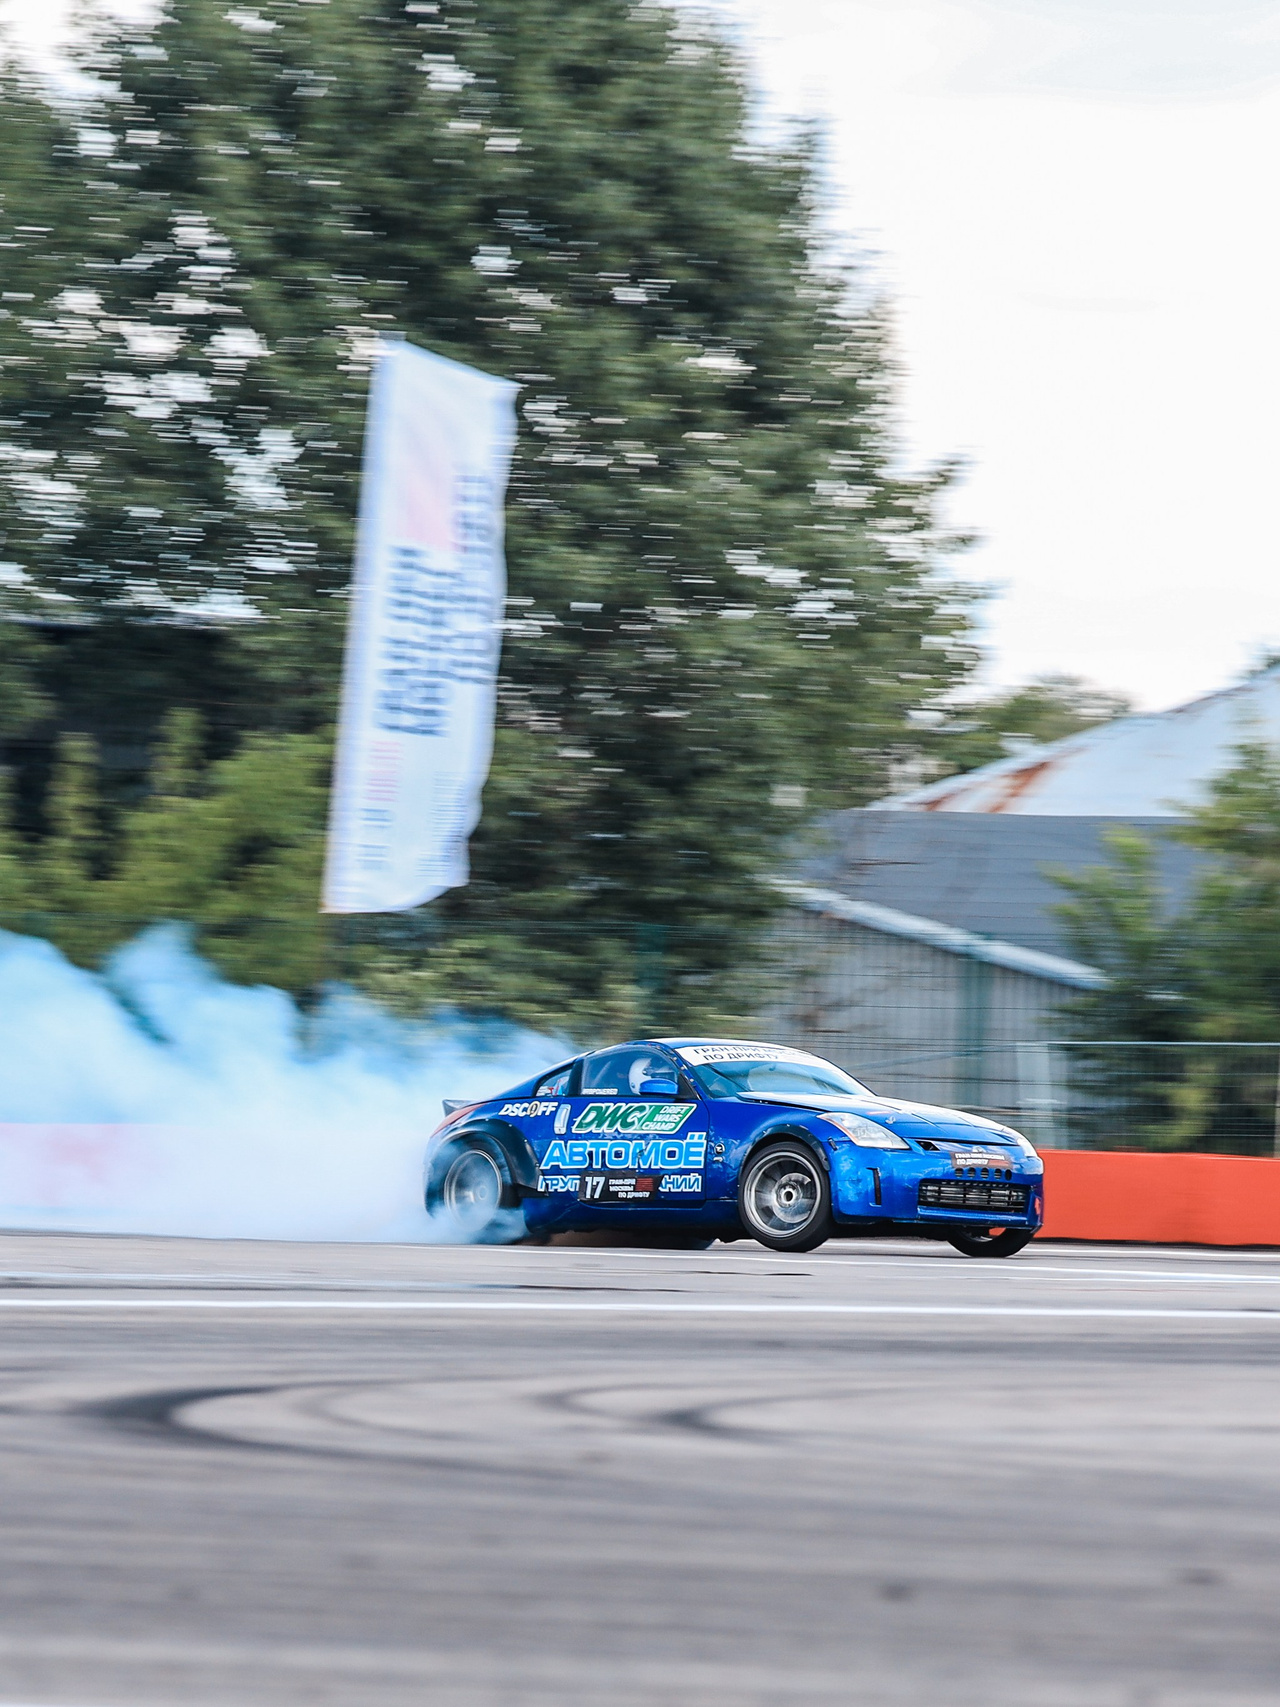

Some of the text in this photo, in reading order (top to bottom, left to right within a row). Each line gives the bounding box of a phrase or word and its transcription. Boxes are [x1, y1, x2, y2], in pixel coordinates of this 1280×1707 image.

[693, 1045, 762, 1055] ГРАН-ПРИ
[727, 1053, 779, 1061] ДРИФТУ
[660, 1106, 690, 1114] DRIFT
[573, 1103, 649, 1133] DWC
[653, 1114, 683, 1122] WARS
[641, 1122, 676, 1131] CHAMP
[539, 1132, 707, 1169] АВТОМОЁ
[537, 1175, 580, 1192] ГРУП
[585, 1176, 605, 1199] 17
